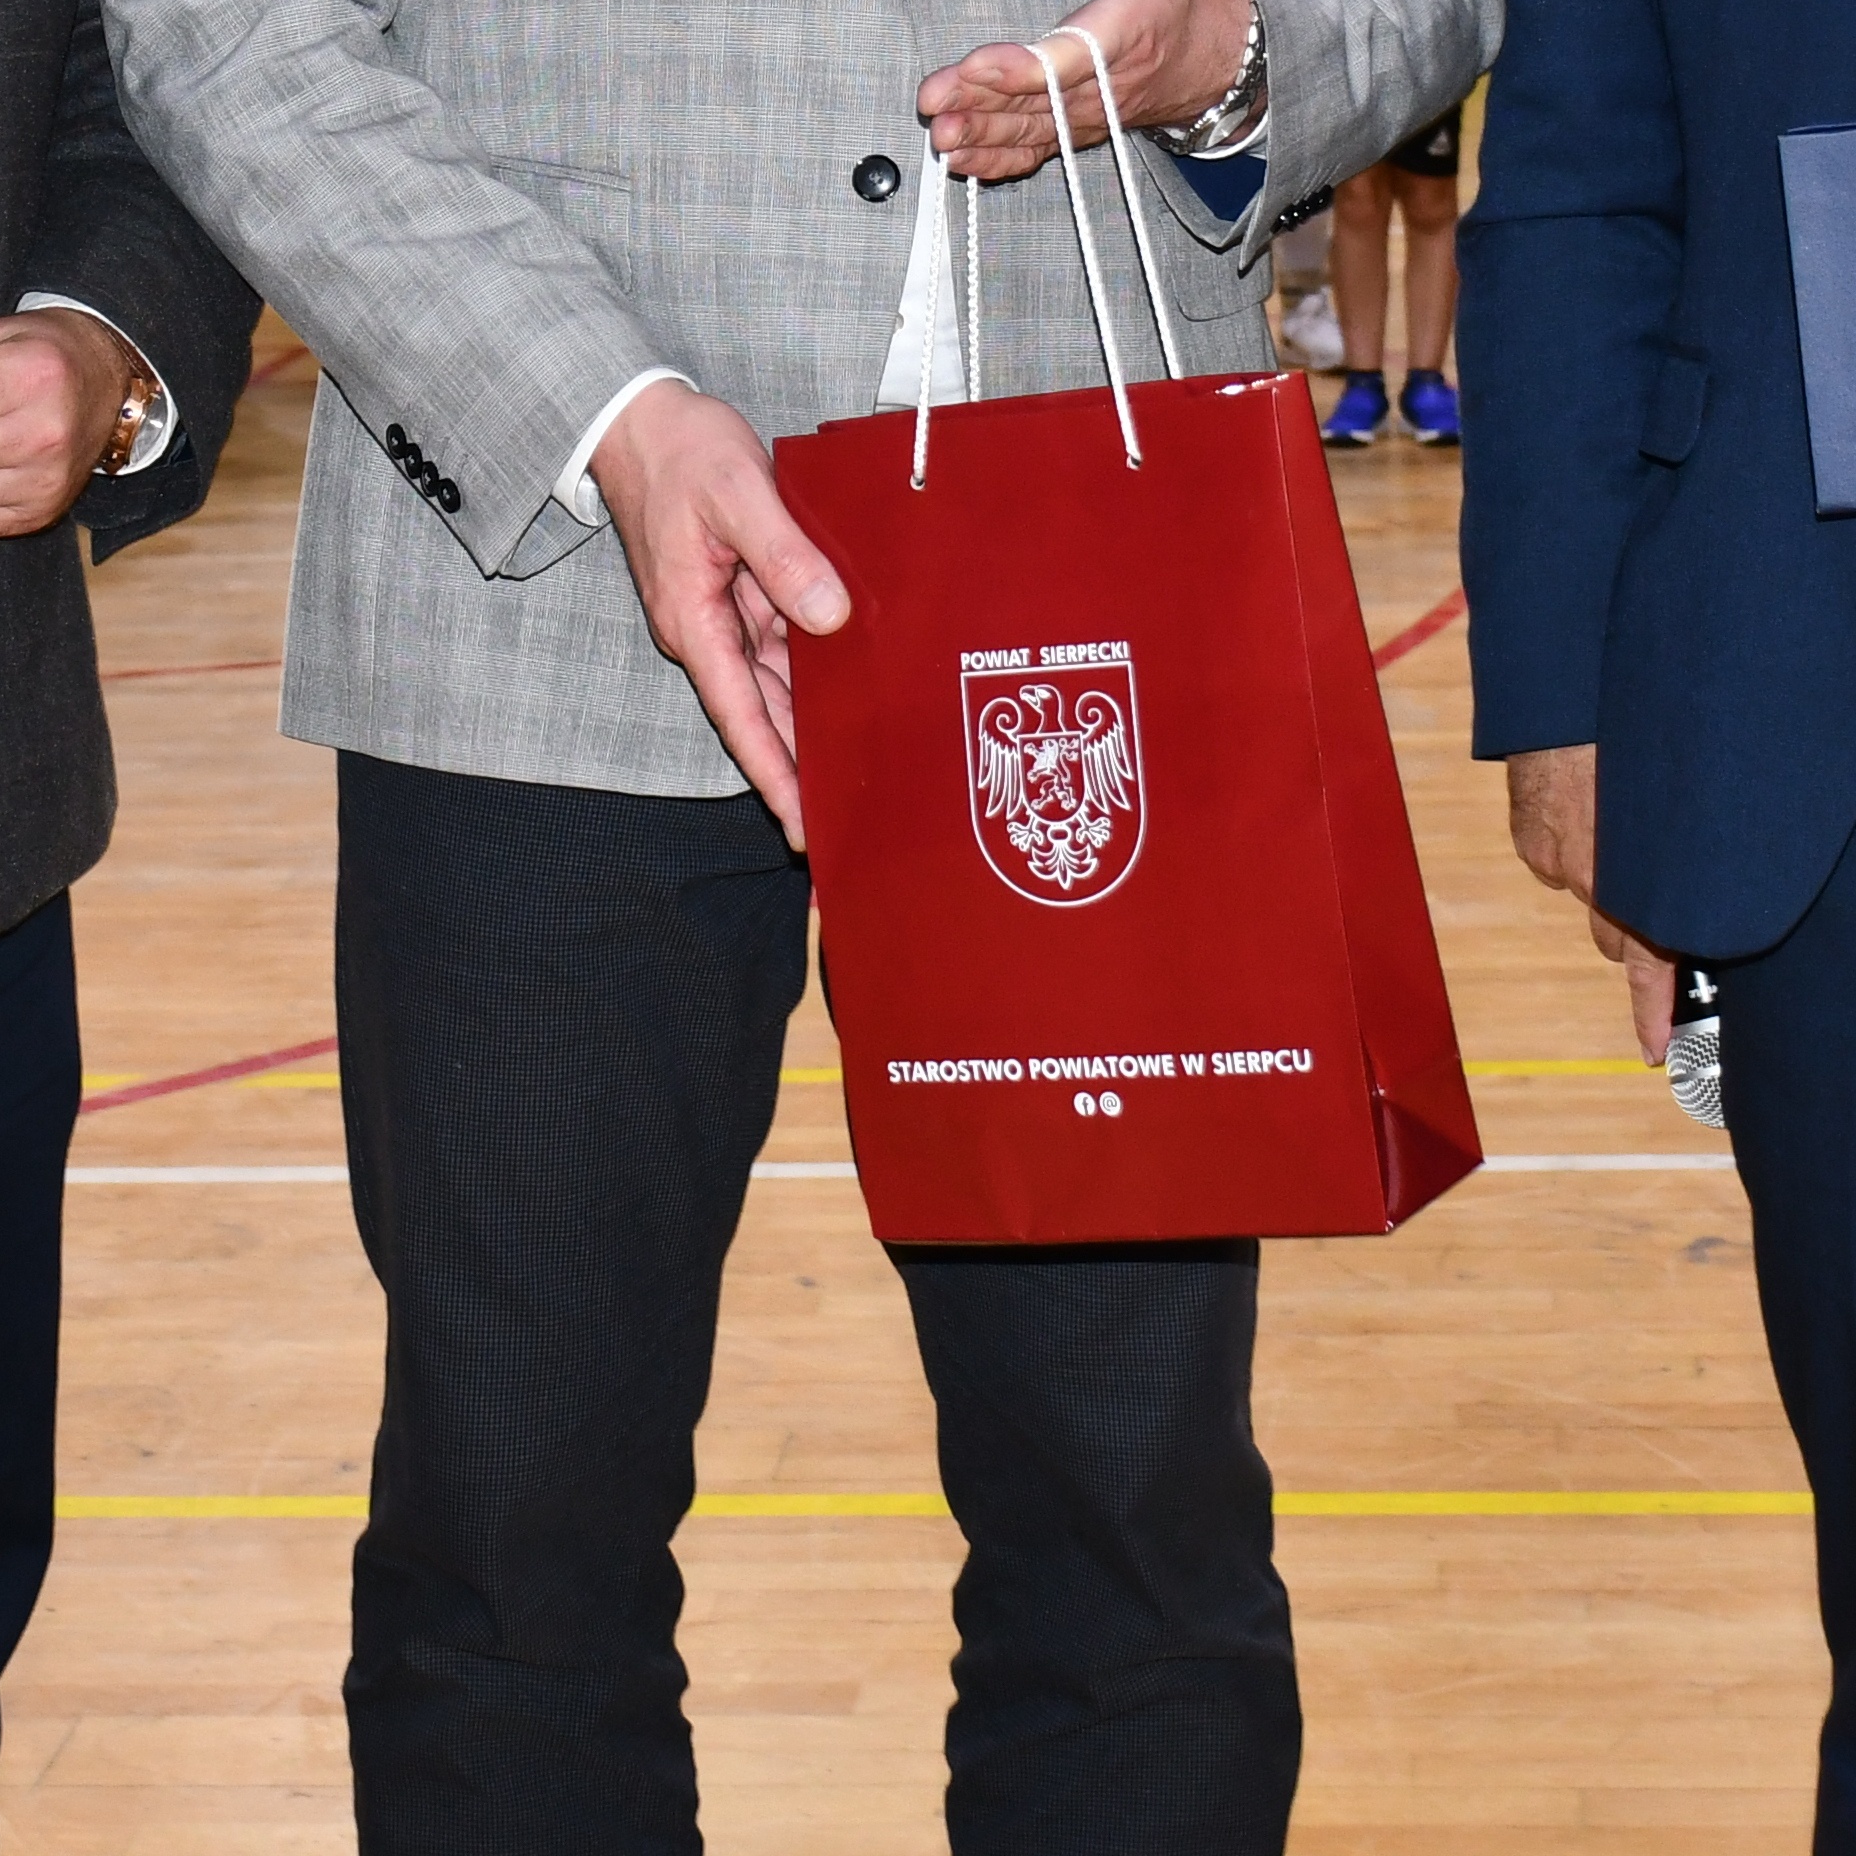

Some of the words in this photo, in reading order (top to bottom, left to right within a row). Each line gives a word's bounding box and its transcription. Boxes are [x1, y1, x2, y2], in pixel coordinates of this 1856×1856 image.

[960, 648, 1031, 670] POWIAT
[1039, 641, 1130, 665] SIERPECKI
[887, 1058, 1023, 1084] STAROSTWO
[1029, 1053, 1176, 1081] POWIATOWE
[1180, 1053, 1205, 1075] W
[1211, 1048, 1313, 1076] SIERPCU
